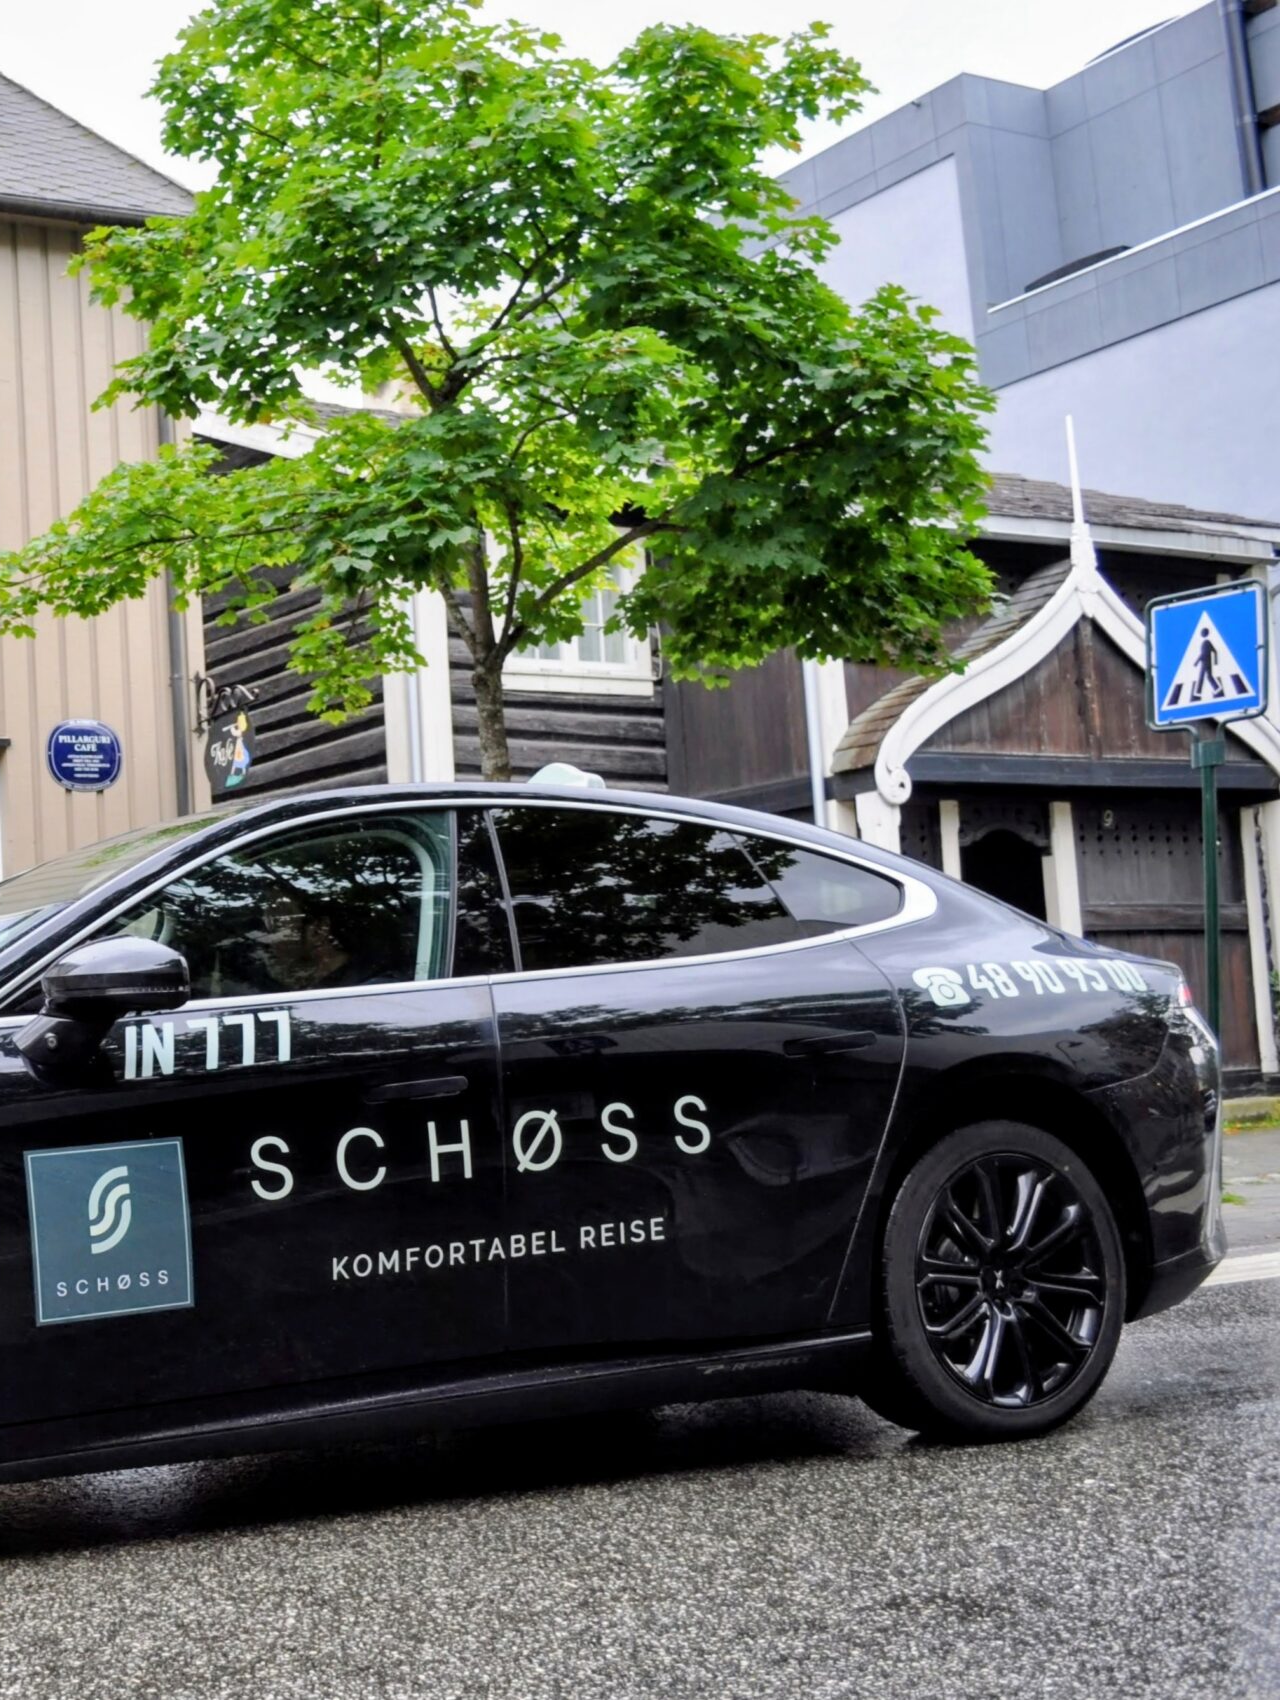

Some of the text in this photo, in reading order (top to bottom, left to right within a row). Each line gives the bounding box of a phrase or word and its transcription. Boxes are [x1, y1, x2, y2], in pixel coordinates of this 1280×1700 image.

[58, 735, 111, 744] PILLARGURI
[1103, 809, 1114, 827] 9
[966, 959, 1148, 999] 48 90 95 00
[124, 1010, 292, 1080] IN 777
[249, 1095, 712, 1202] SCHØSS
[331, 1217, 666, 1282] KOMFORTABEL REISE
[56, 1269, 169, 1298] SCHØSS
